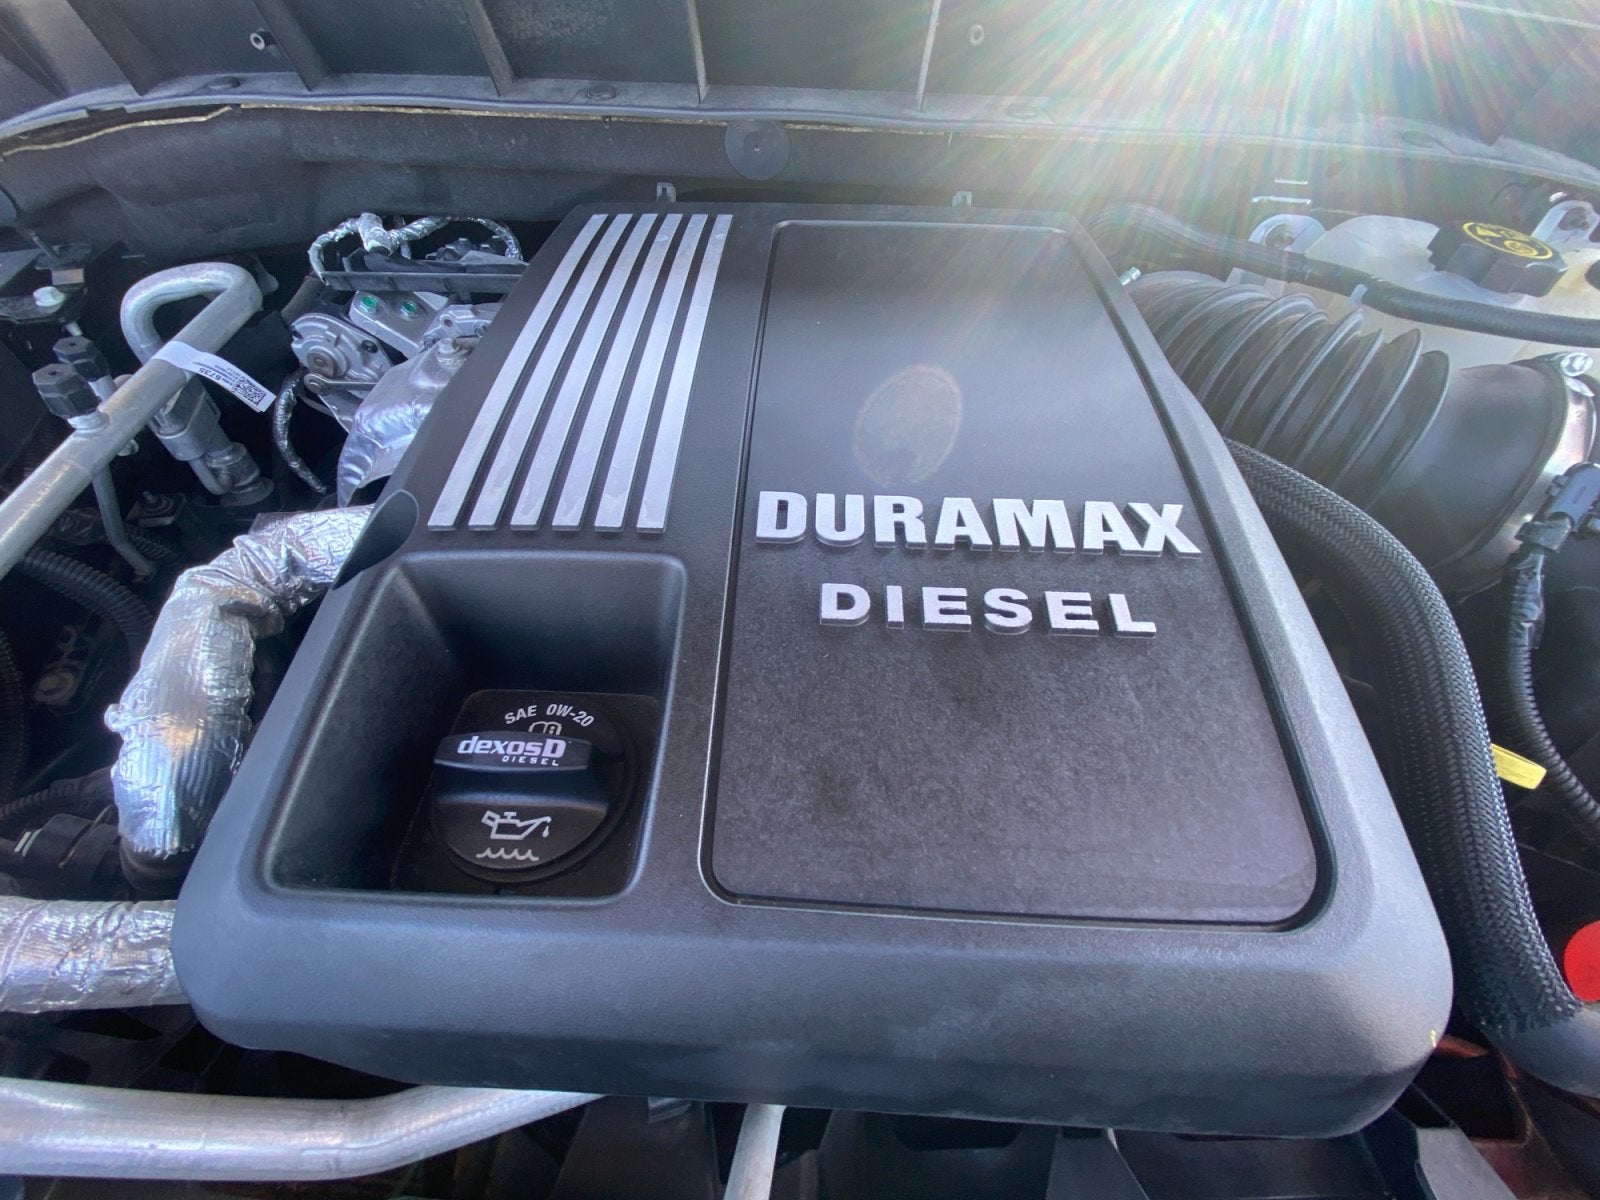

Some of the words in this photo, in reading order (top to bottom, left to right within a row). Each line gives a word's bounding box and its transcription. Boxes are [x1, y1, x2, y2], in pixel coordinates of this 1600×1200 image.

[756, 490, 1202, 558] DURAMAX
[820, 582, 1157, 638] DIESEL
[504, 704, 537, 725] SAE
[546, 703, 595, 727] 0W-20
[457, 735, 567, 758] dexosD
[501, 755, 560, 767] DIESEL
